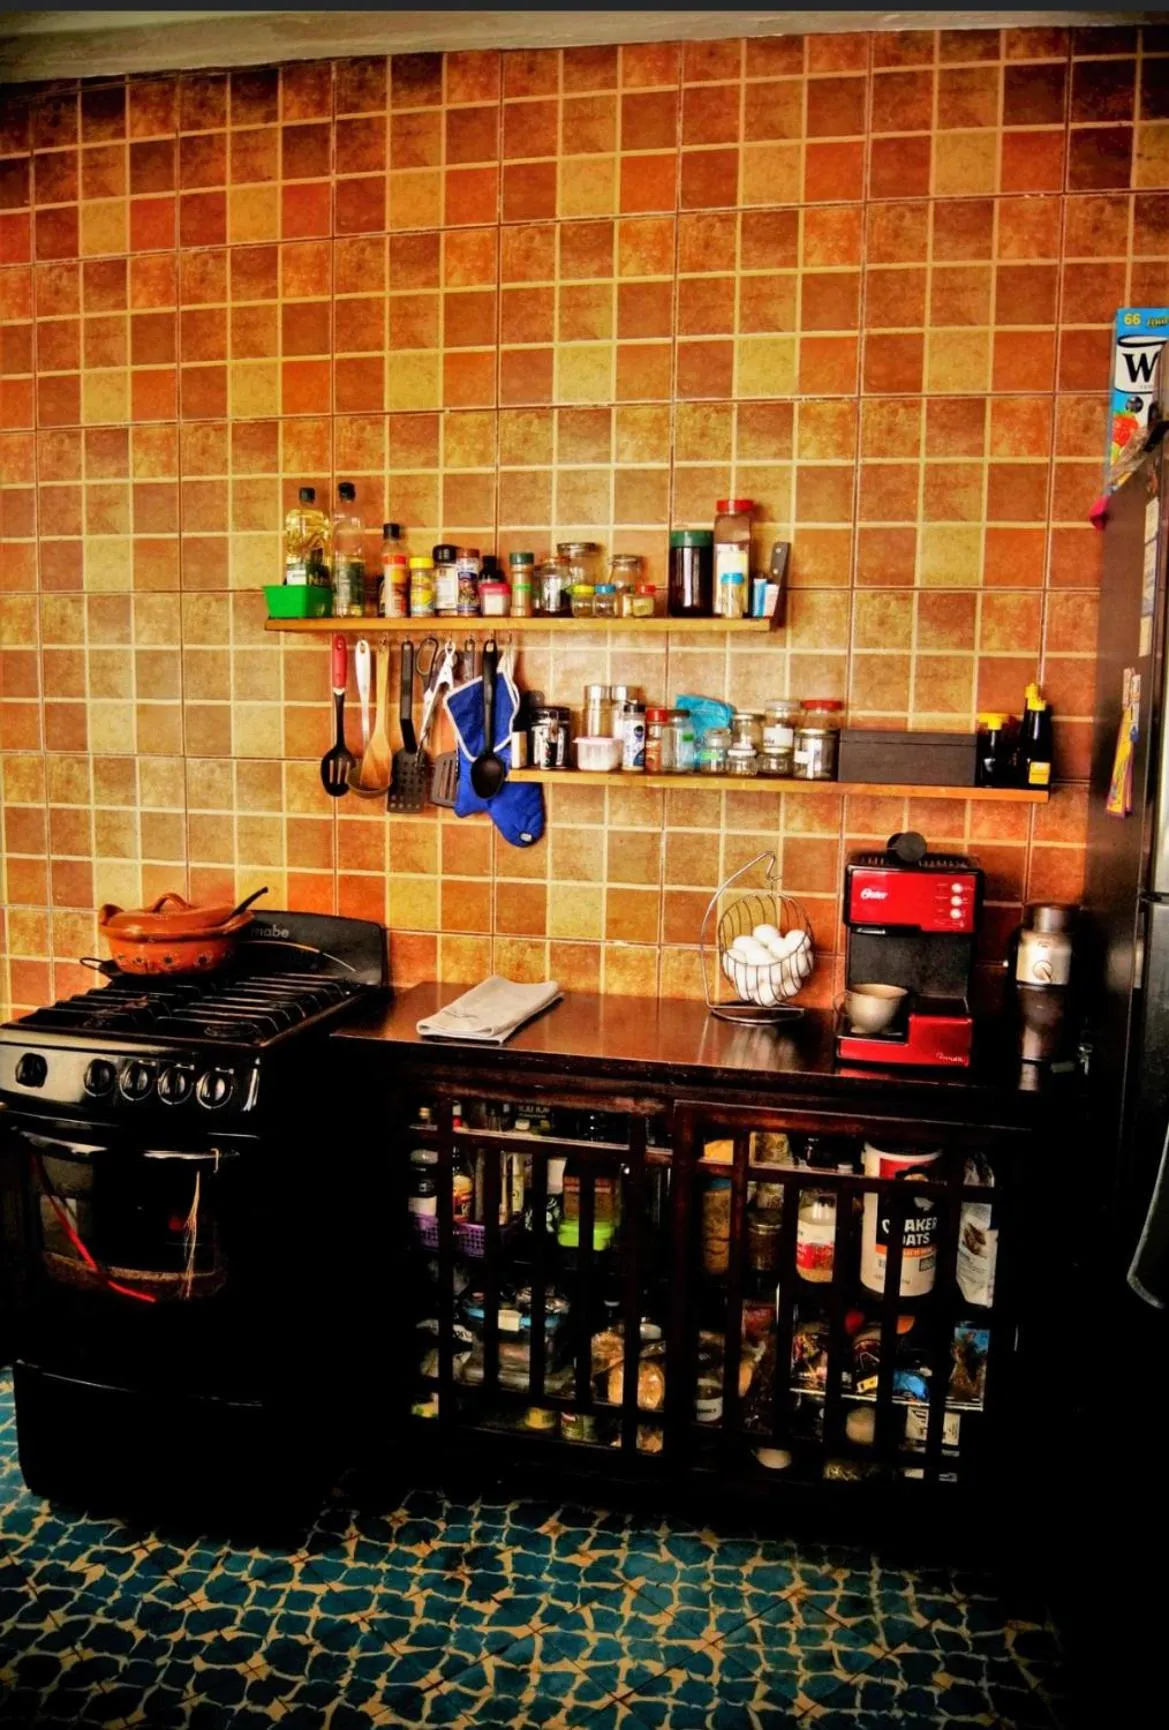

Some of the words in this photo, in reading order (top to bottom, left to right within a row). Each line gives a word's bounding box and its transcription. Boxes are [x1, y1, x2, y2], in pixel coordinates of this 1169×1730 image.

[1123, 313, 1141, 326] 66
[881, 1217, 937, 1234] QAKER
[902, 1232, 930, 1246] ATS
